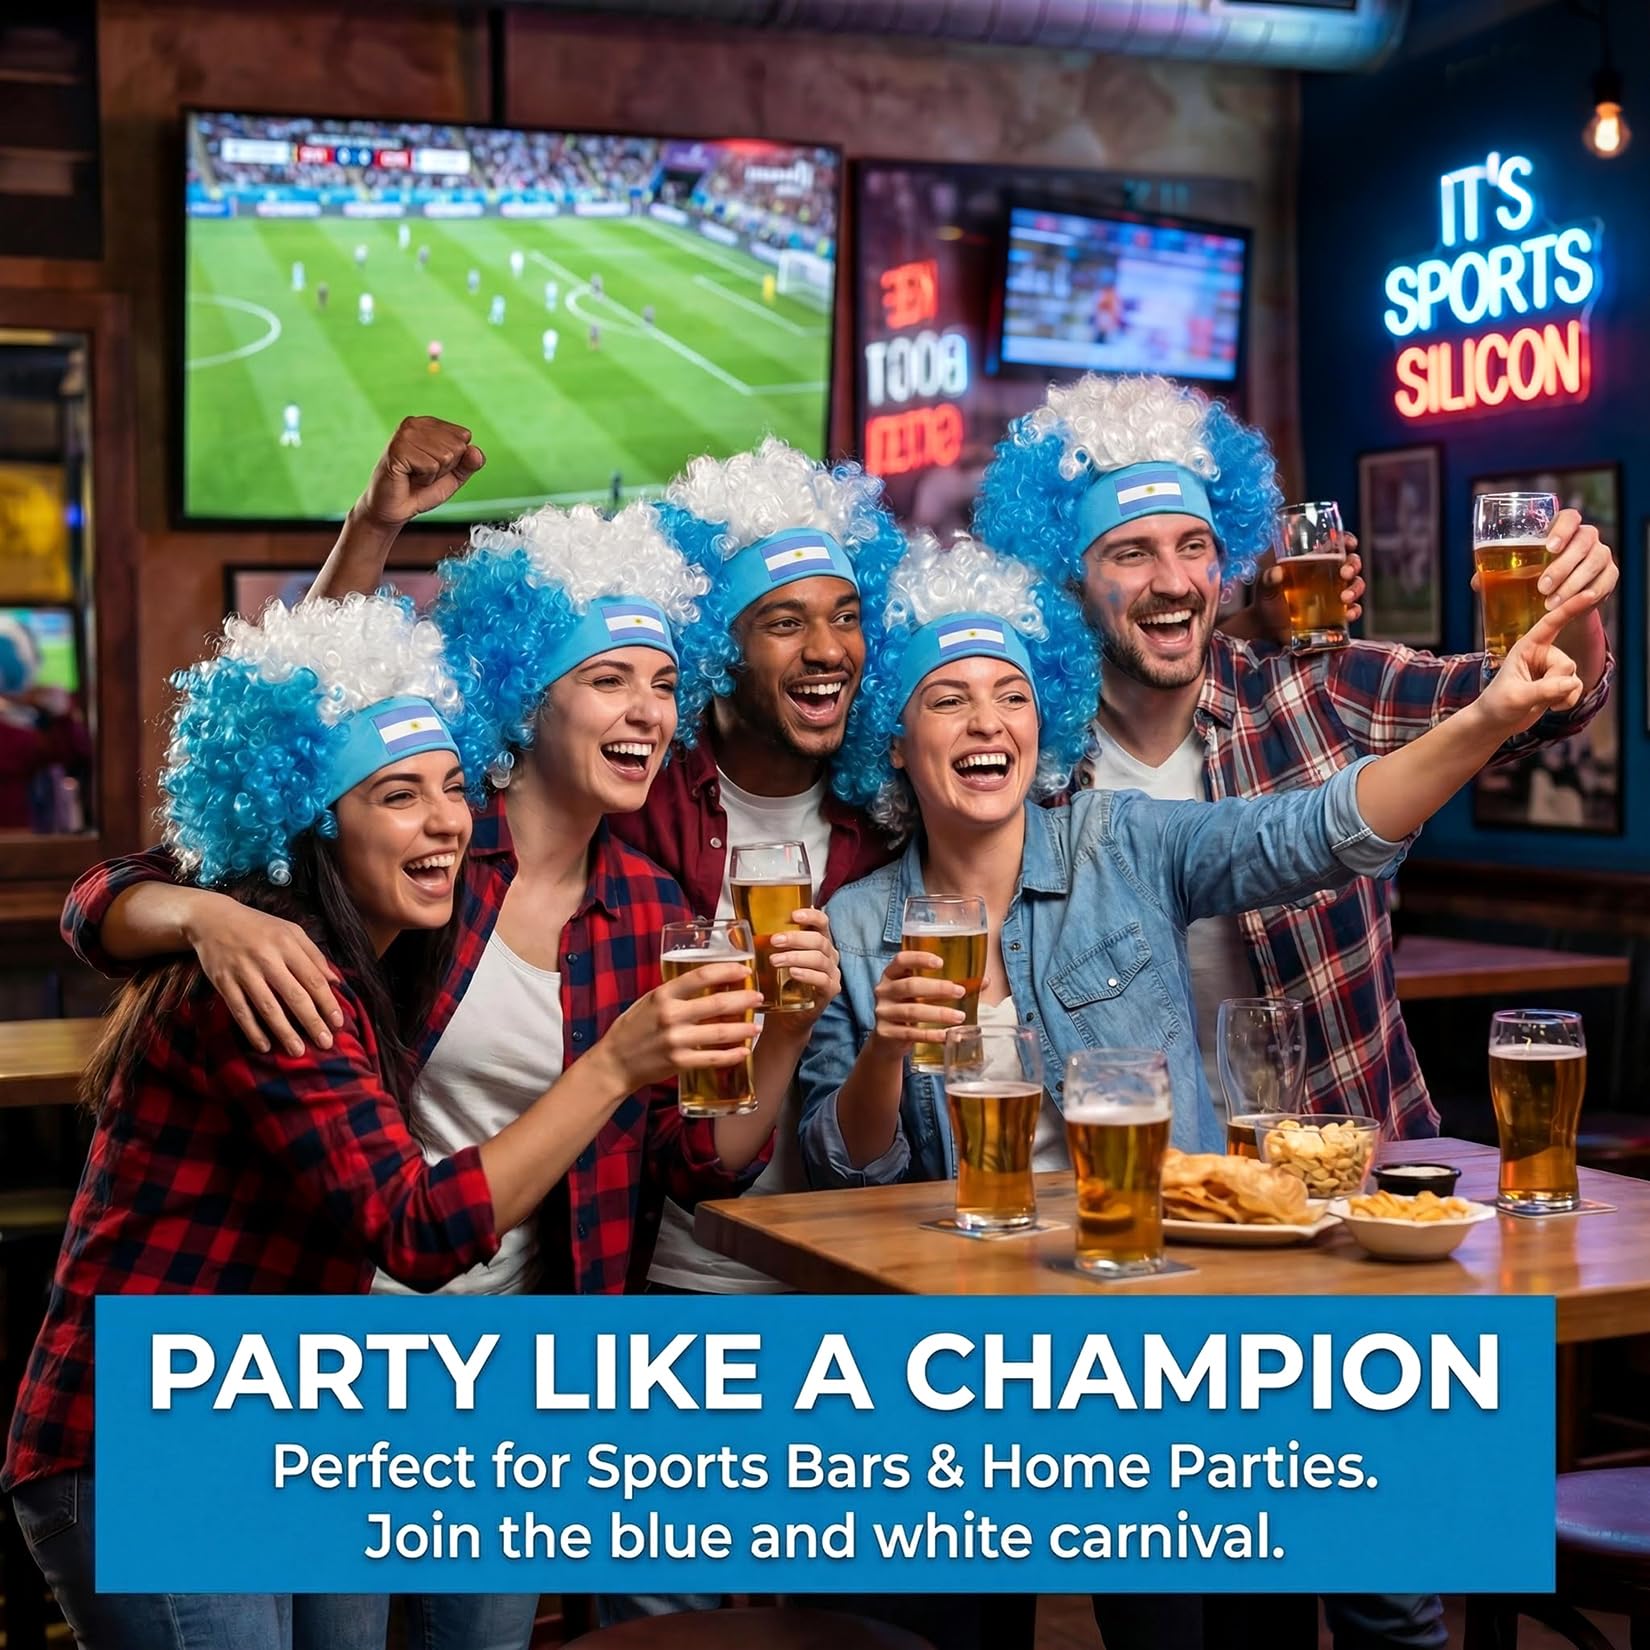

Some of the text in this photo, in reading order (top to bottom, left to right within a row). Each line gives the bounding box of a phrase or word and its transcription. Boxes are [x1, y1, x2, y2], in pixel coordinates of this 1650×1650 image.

[1440, 150, 1534, 247] IT'S
[1384, 227, 1594, 337] SPORTS
[1394, 319, 1581, 418] SILICON
